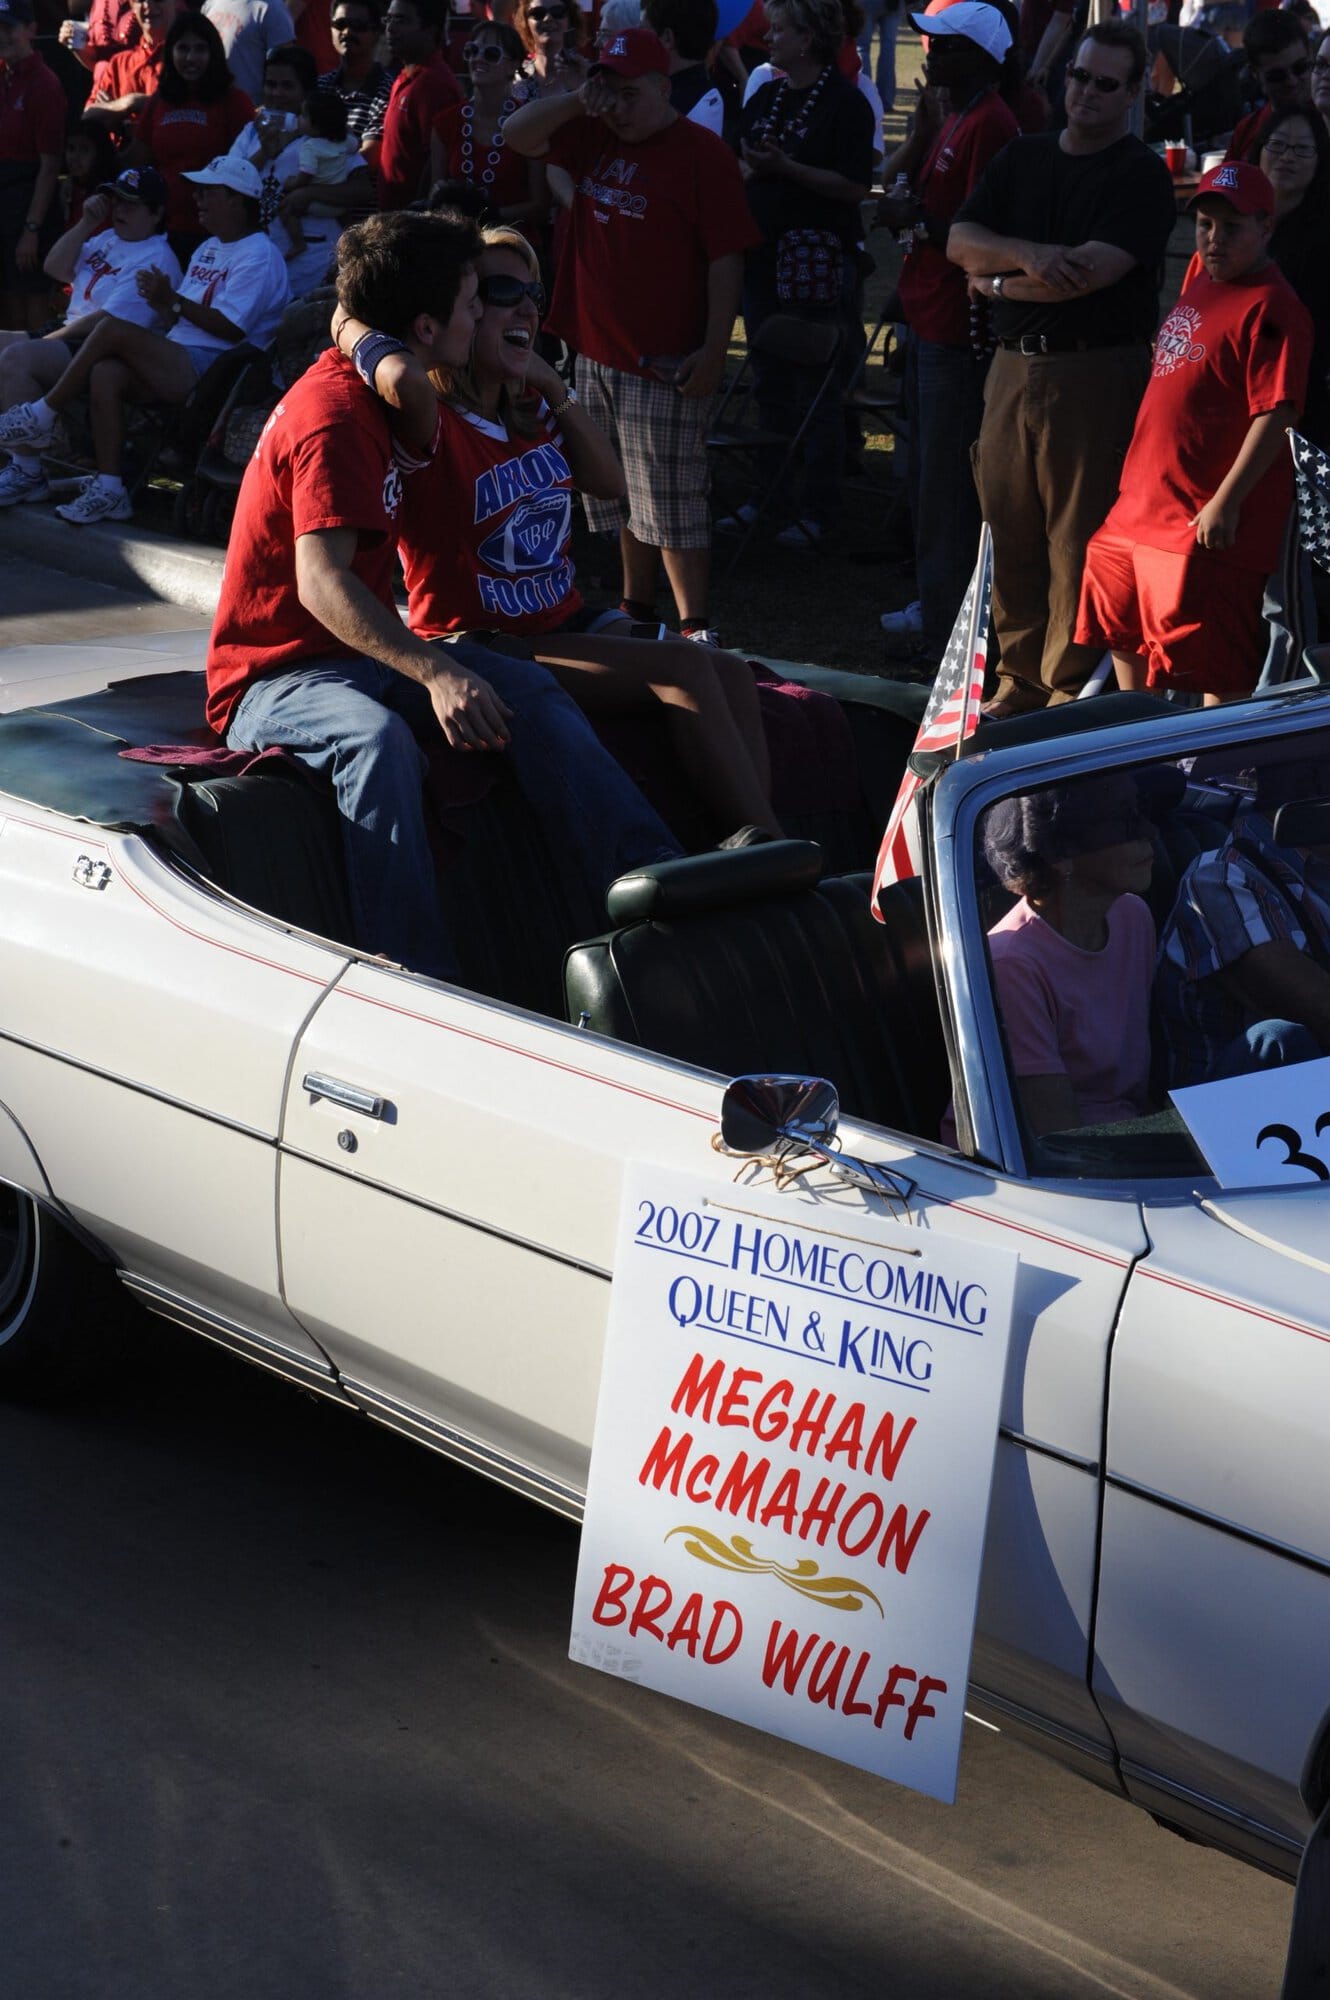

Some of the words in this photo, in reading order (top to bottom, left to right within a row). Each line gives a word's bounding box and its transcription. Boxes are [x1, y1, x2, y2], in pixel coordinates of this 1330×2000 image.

[1211, 166, 1239, 188] A
[1256, 1111, 1330, 1181] 3
[635, 1199, 721, 1252] 2007
[732, 1223, 987, 1325] HOMECOMING
[668, 1276, 789, 1342] QUEEN
[803, 1312, 826, 1353] &
[839, 1319, 933, 1381] KING
[671, 1352, 917, 1482] MEGHAN
[592, 1563, 743, 1666] BRAD
[762, 1620, 947, 1741] WULFF
